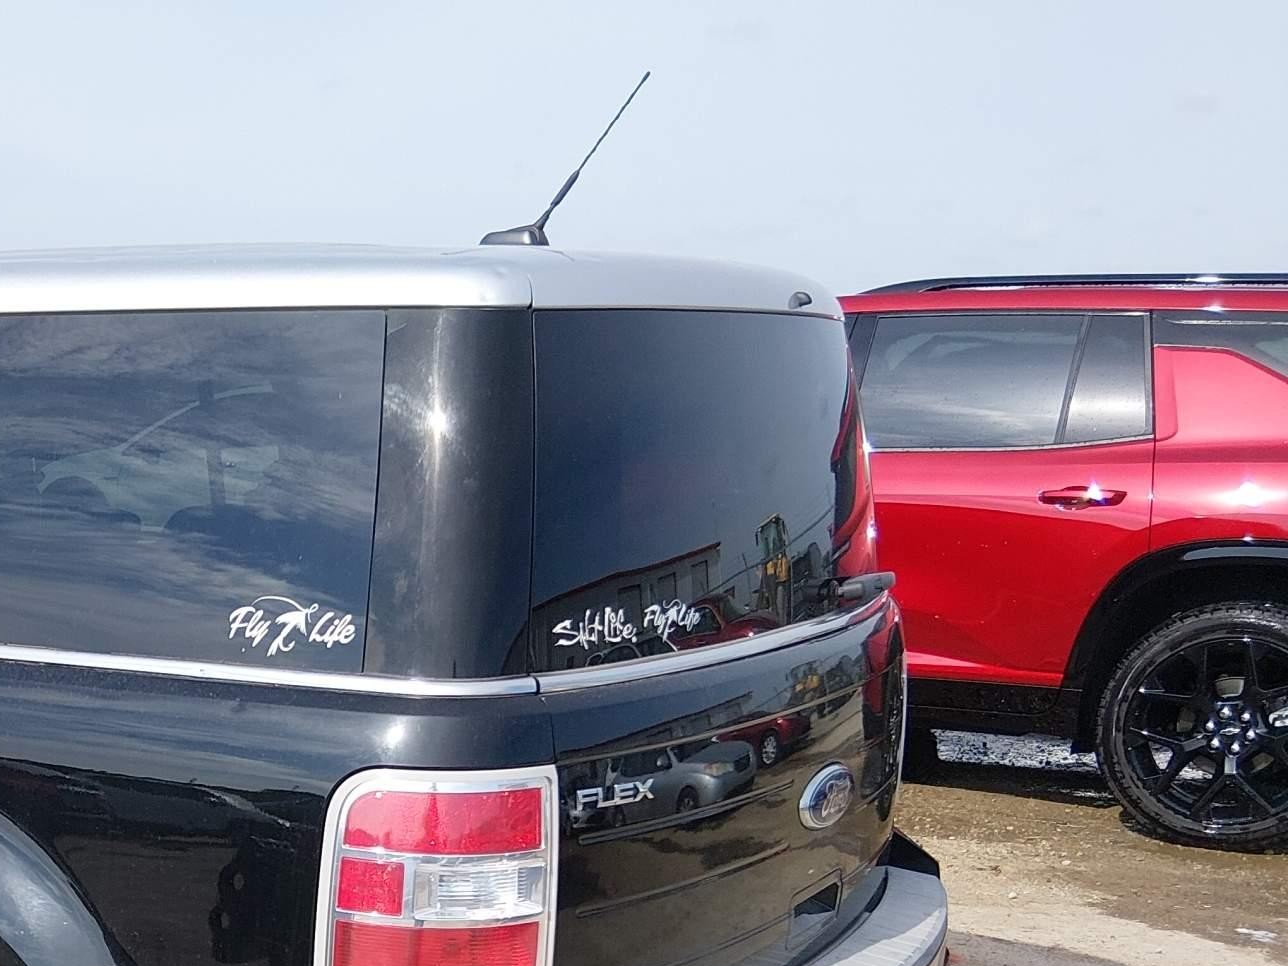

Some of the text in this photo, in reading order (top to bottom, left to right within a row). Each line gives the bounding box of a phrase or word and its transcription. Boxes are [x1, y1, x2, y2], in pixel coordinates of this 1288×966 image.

[229, 606, 355, 648] Fly Life
[643, 603, 701, 633] Fly Life
[576, 778, 655, 811] FLEX
[821, 776, 853, 818] Ford
